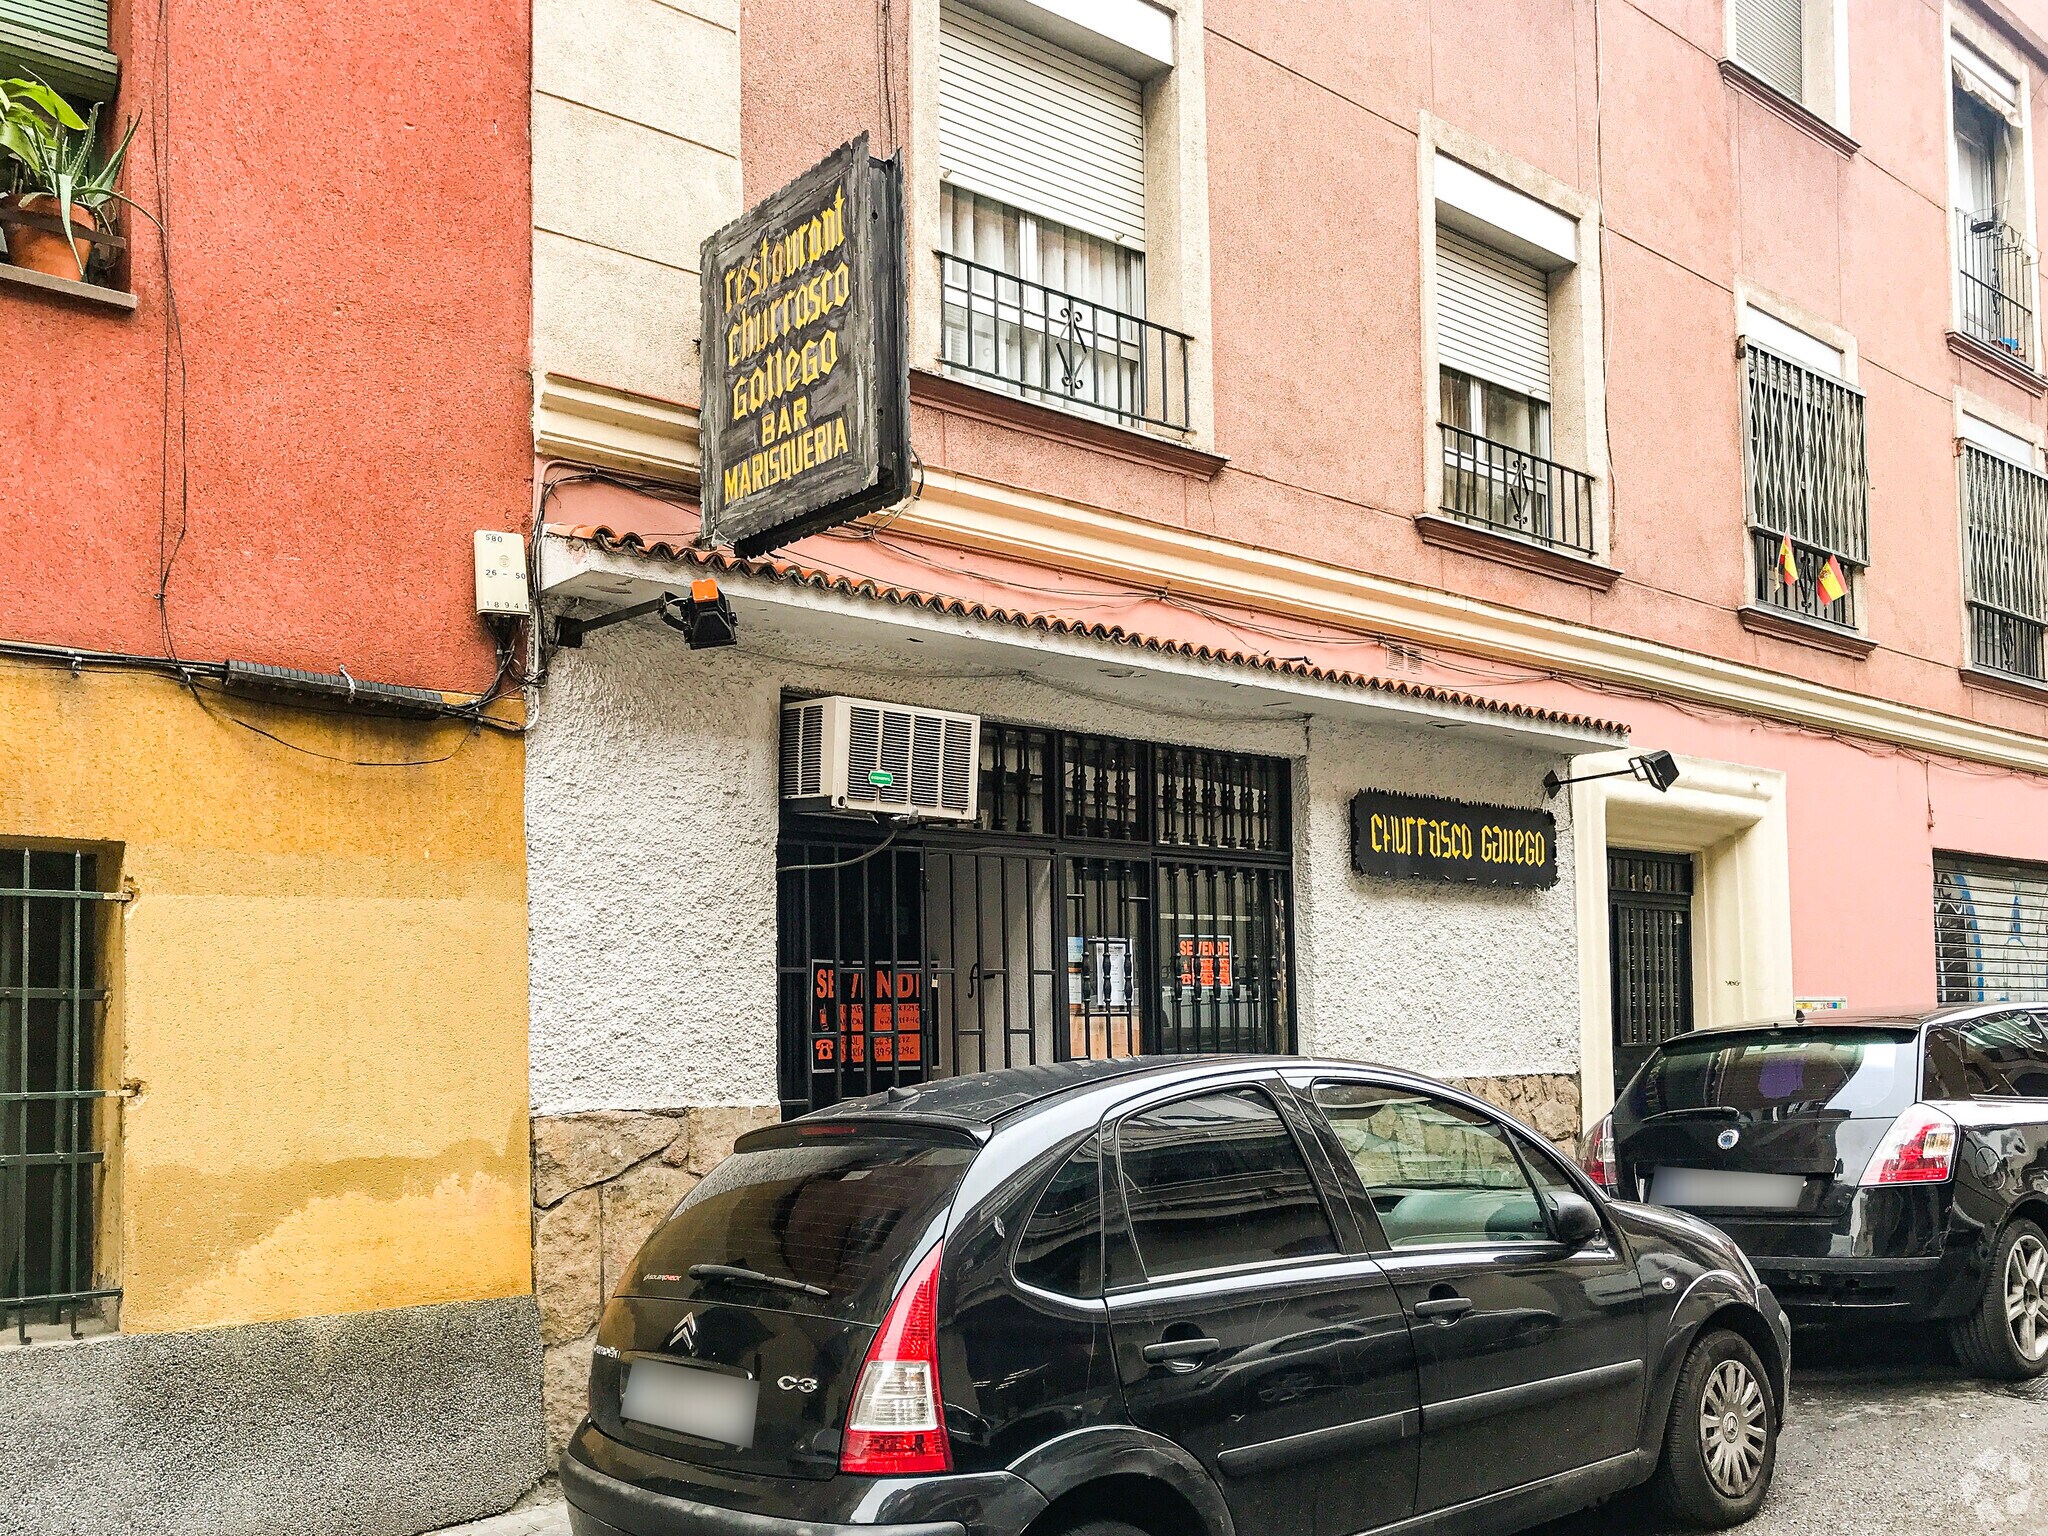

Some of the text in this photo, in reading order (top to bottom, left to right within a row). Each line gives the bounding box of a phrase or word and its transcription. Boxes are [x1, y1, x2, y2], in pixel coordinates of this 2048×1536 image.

[761, 396, 808, 447] BAR
[724, 417, 848, 505] MARISQUERIA
[485, 533, 503, 543] 580
[485, 569, 497, 577] 26
[515, 572, 526, 580] 50
[1630, 873, 1653, 892] 19
[1180, 940, 1194, 956] SE
[777, 1375, 818, 1393] C3
